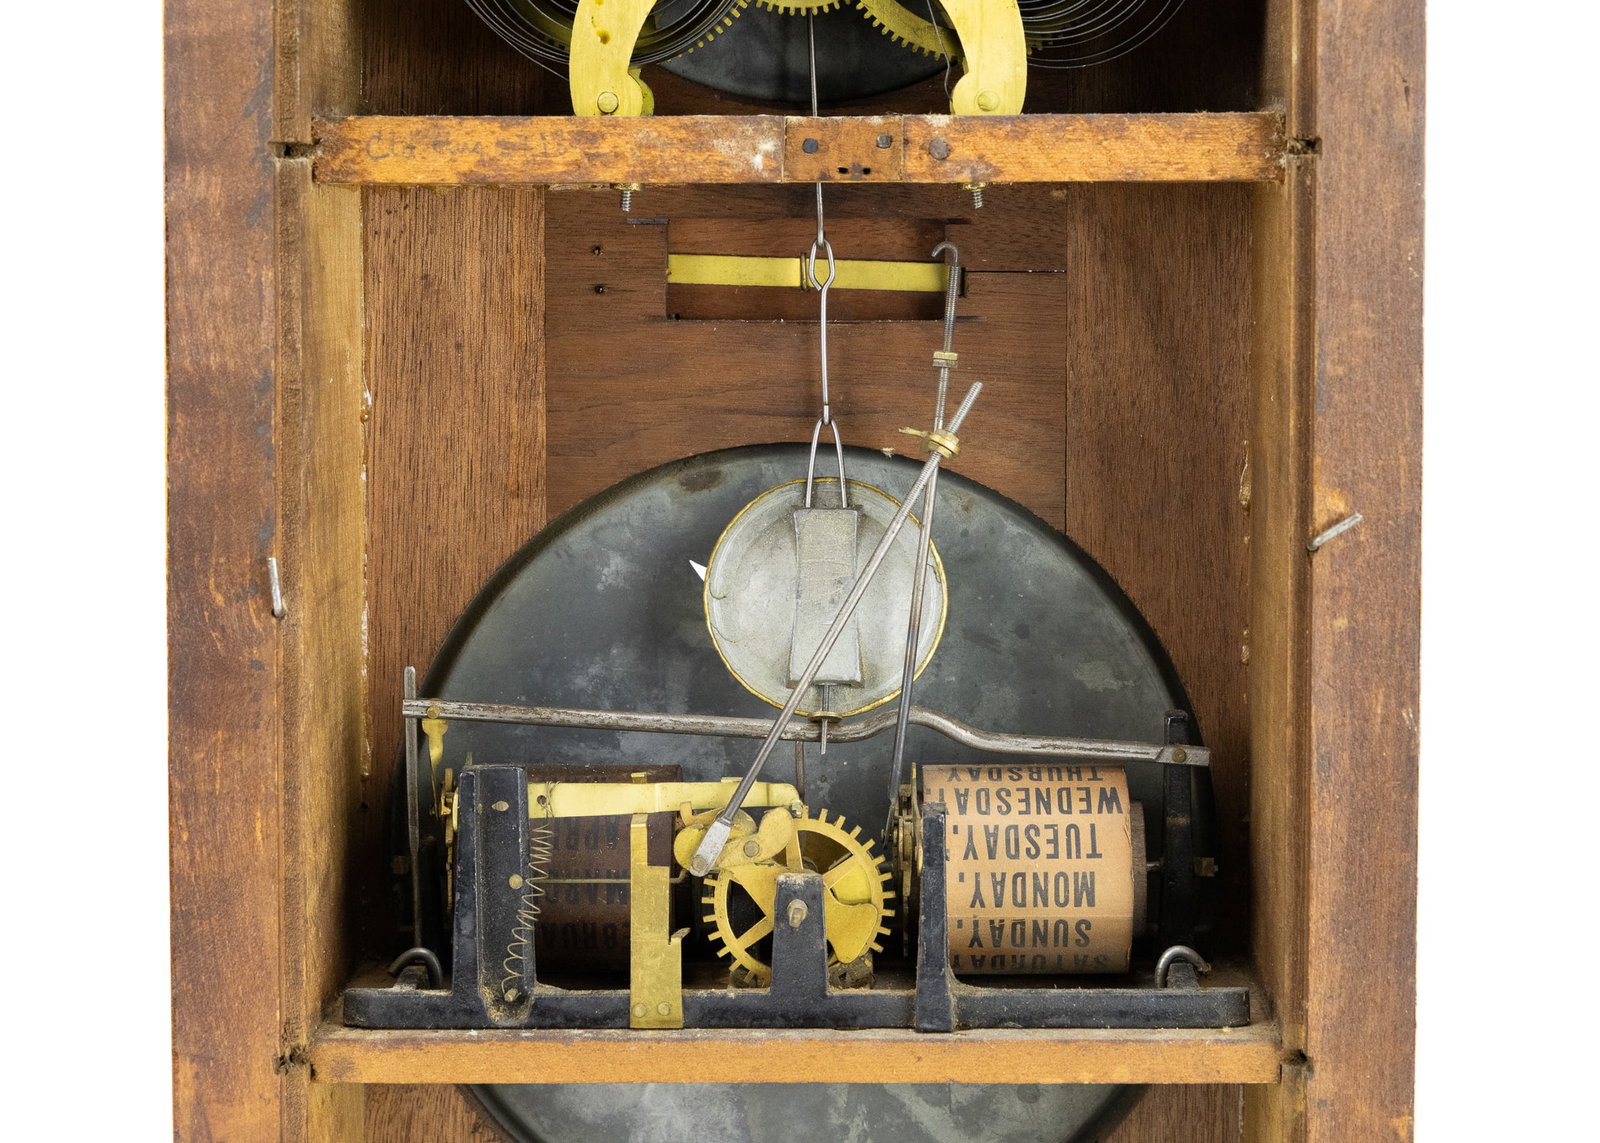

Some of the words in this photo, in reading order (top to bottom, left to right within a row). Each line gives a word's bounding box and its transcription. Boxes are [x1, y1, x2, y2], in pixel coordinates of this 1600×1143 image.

[953, 823, 1102, 860] TUESDAY.
[958, 871, 1096, 908] MONDAY.
[956, 919, 1092, 948] SUNDAY.
